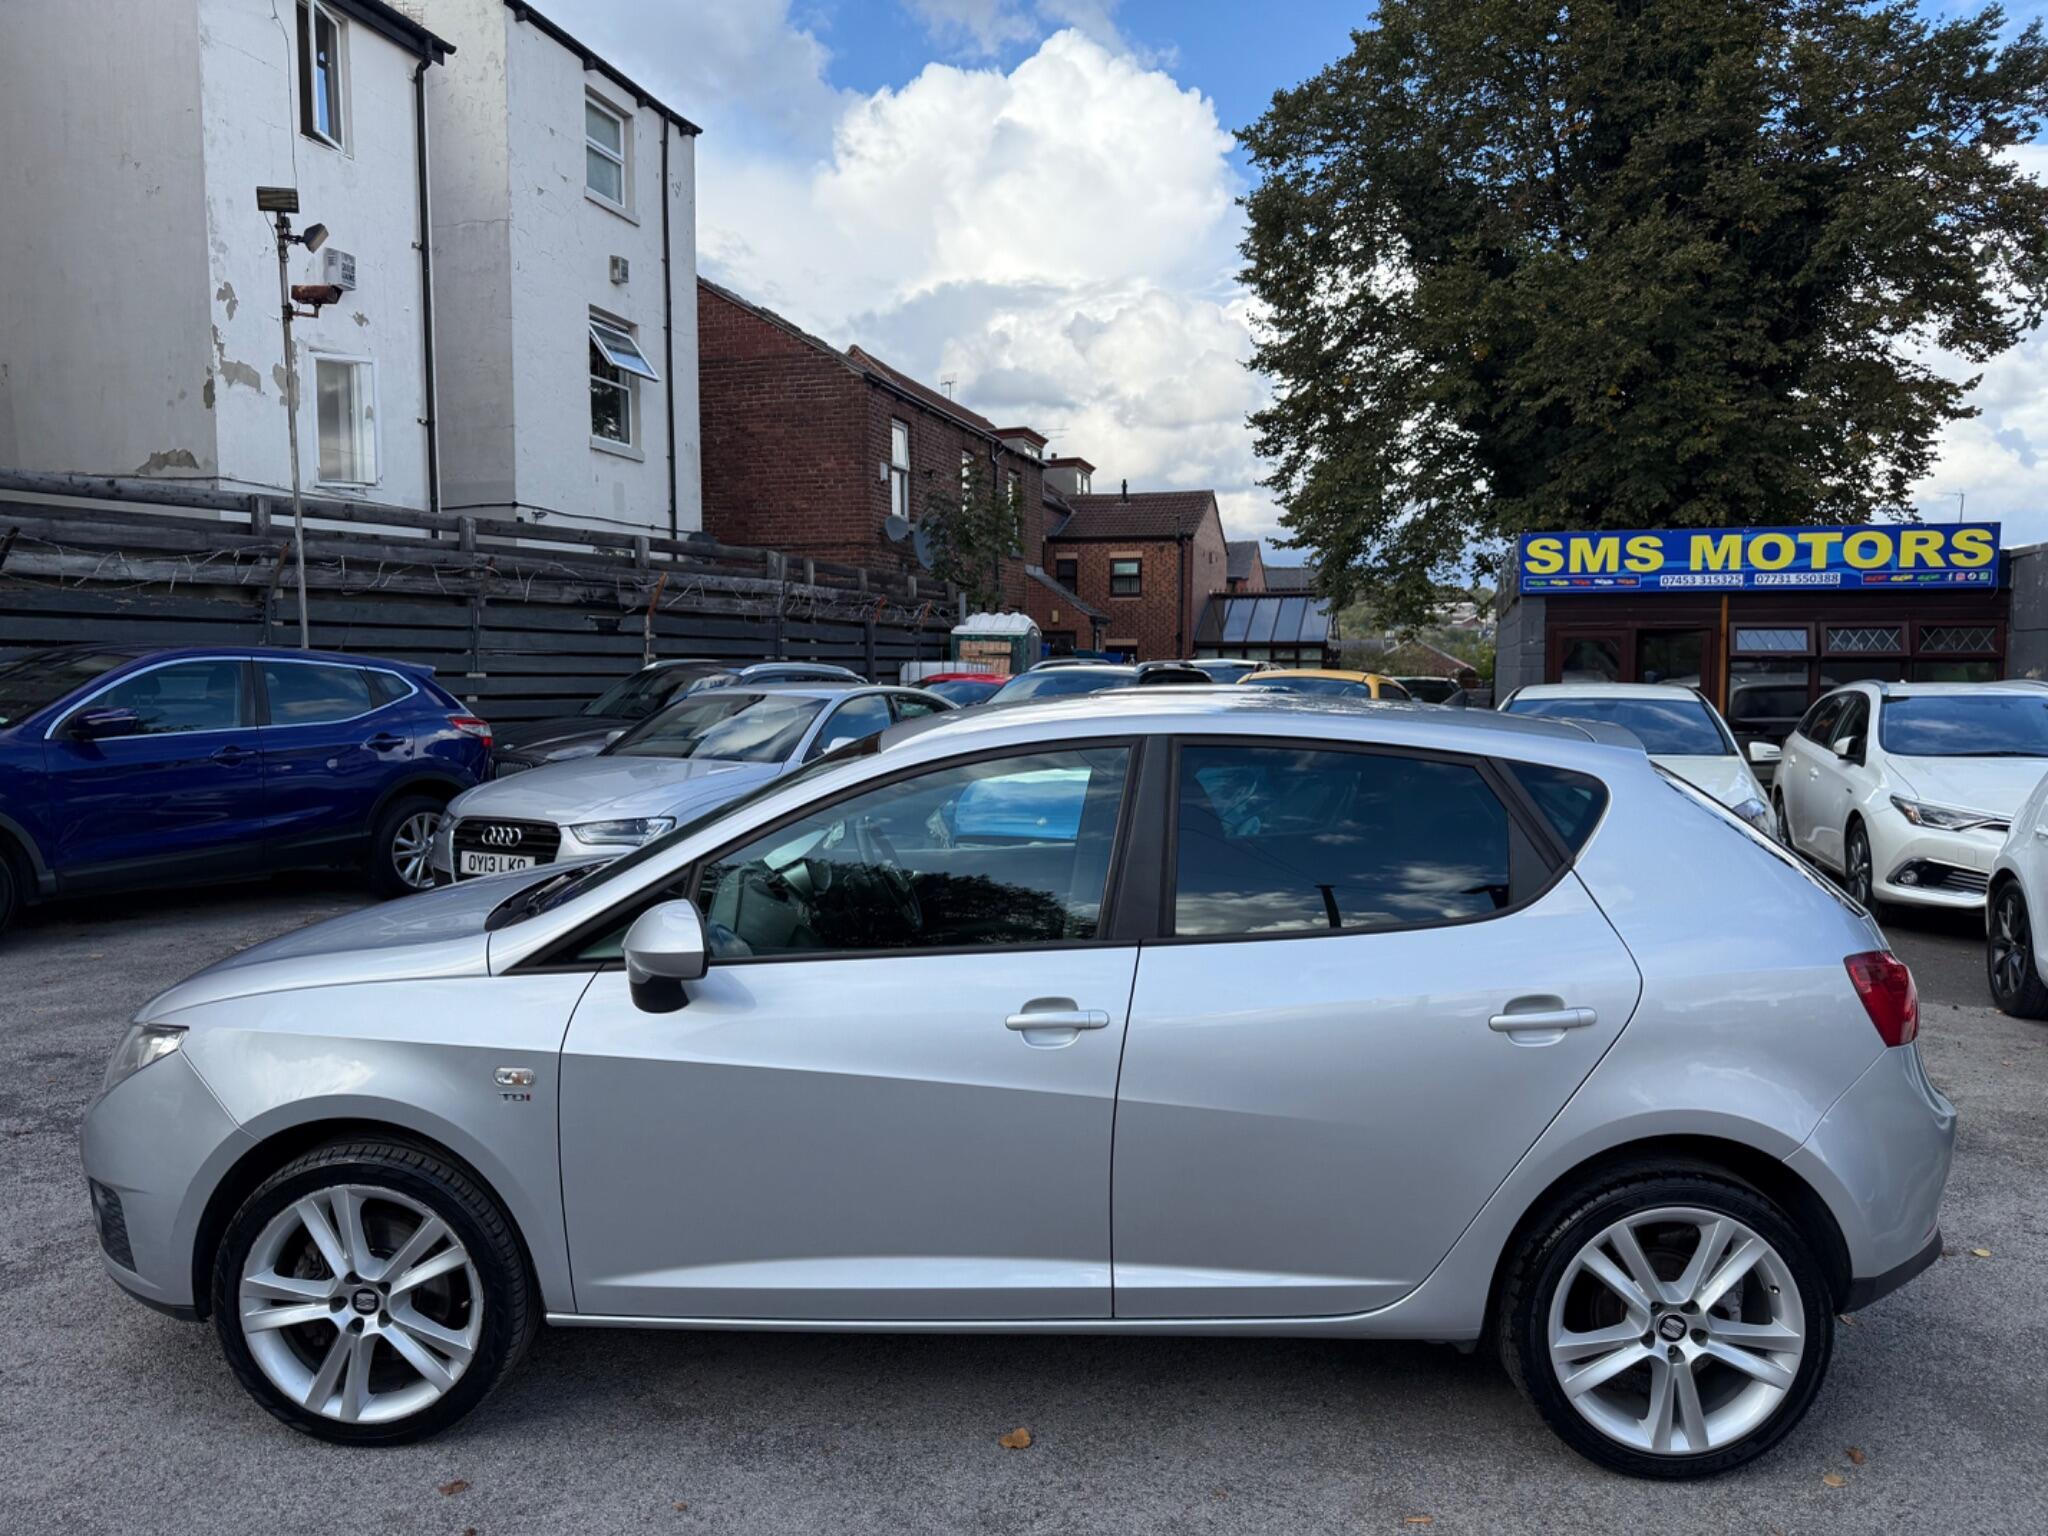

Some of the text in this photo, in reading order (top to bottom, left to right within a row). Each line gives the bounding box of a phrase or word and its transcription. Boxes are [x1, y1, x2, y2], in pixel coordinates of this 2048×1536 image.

[1524, 528, 1994, 575] SMS MOTORS
[1661, 575, 1696, 586] 07453
[1756, 574, 1791, 584] 07731
[468, 854, 496, 873] OY13
[499, 1093, 531, 1102] TDI
